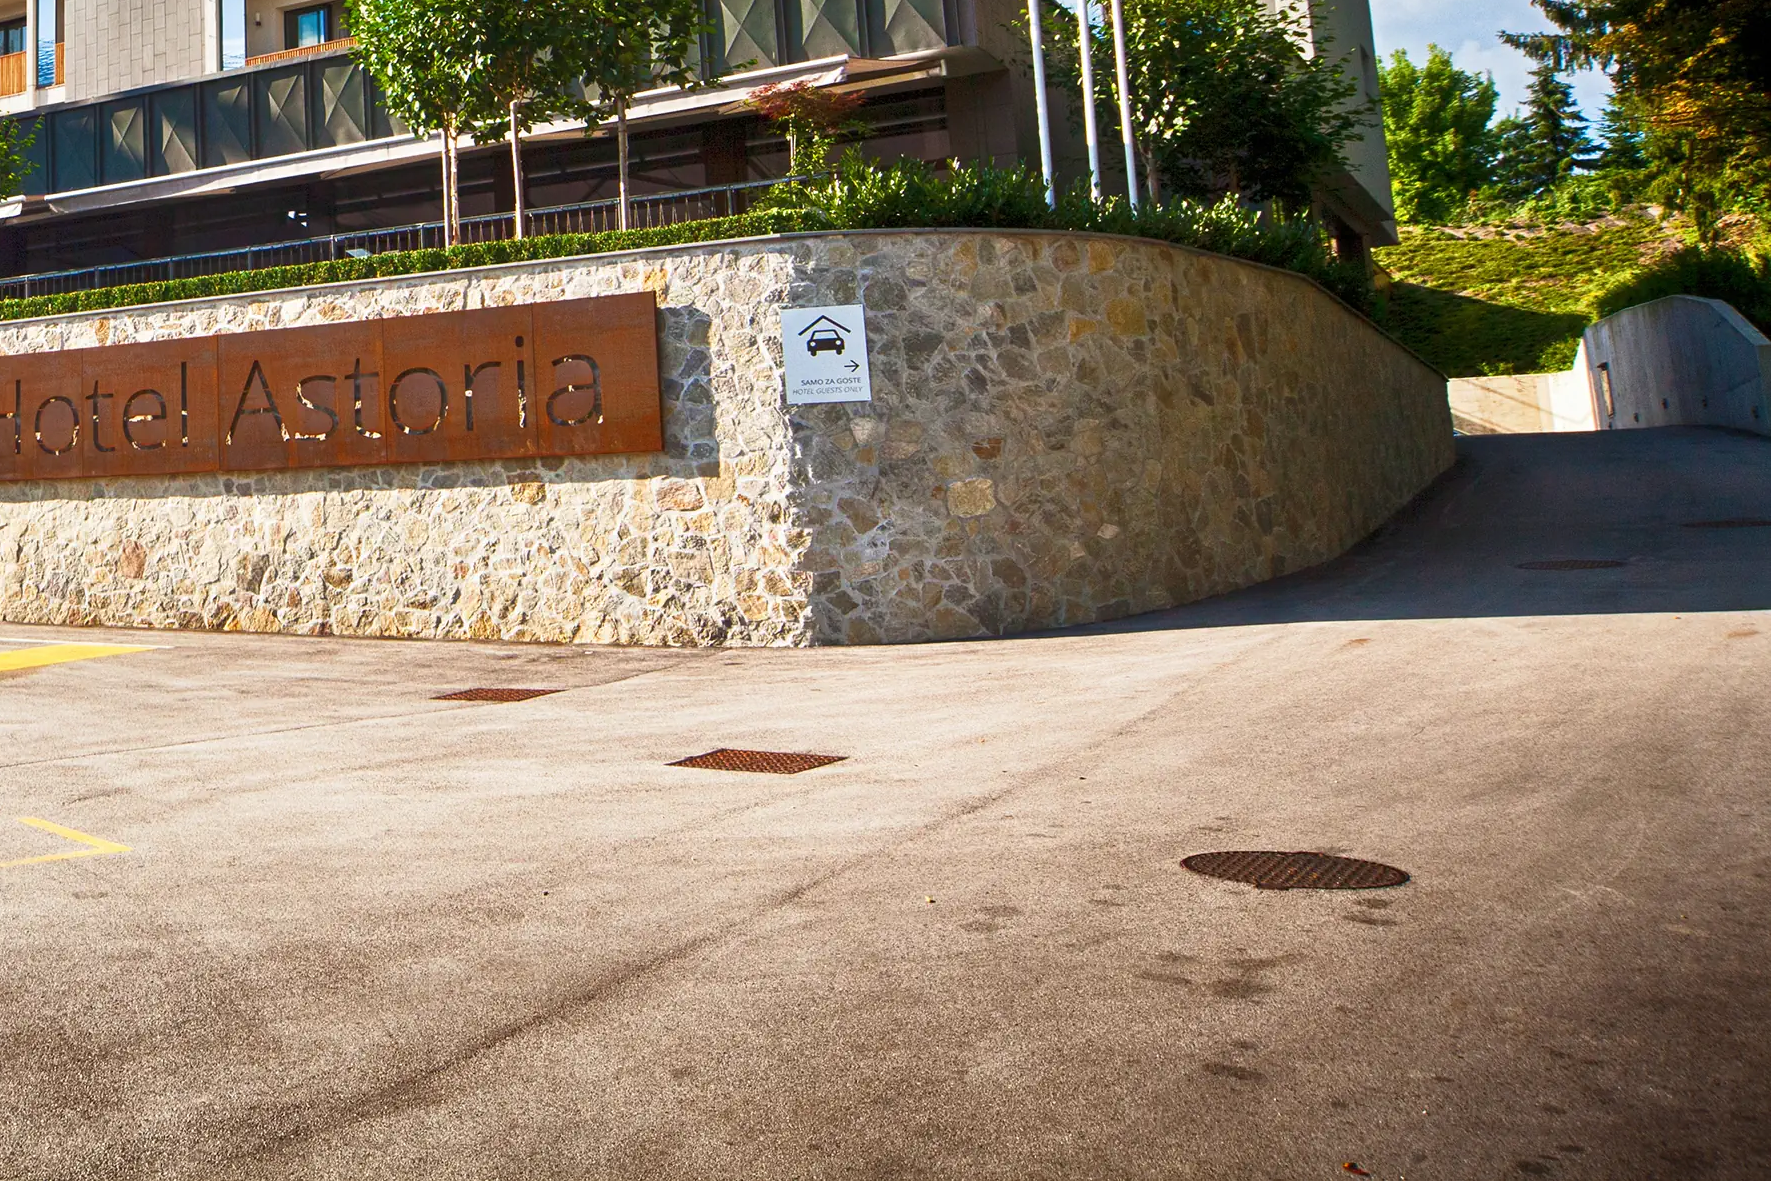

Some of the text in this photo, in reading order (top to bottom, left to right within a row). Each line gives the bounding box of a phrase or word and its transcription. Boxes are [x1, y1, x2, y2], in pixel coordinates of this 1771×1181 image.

[225, 335, 606, 447] Astoria
[792, 388, 814, 396] HOTEL
[815, 387, 842, 395] GUESTS
